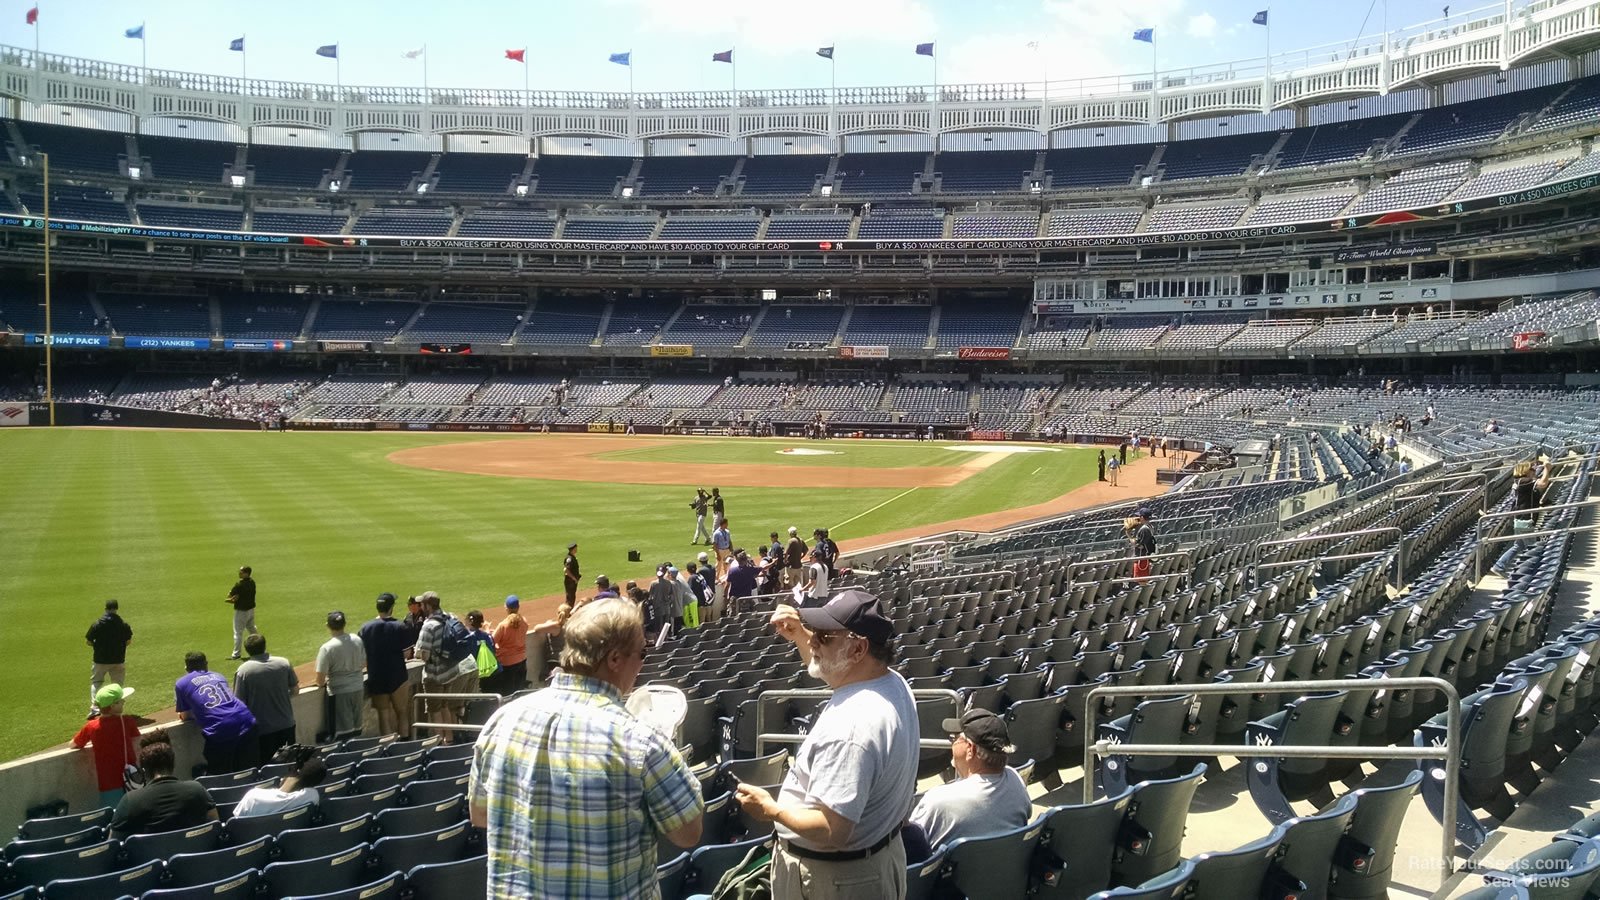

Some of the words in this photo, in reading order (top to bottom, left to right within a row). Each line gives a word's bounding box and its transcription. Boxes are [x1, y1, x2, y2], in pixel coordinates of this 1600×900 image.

[1499, 195, 1517, 206] BUY
[1519, 194, 1526, 202] A
[1527, 189, 1541, 201] $50
[1541, 181, 1579, 197] YANKEES
[1579, 175, 1599, 188] GIFT
[81, 225, 130, 235] #MobilizingNYY
[232, 233, 242, 241] the
[902, 242, 917, 250] $50
[1028, 240, 1052, 248] YOUR
[1117, 237, 1135, 245] AND
[1137, 235, 1159, 244] HAVE
[1162, 234, 1175, 243] $10
[1177, 232, 1208, 241] ADDED
[1211, 231, 1222, 239] TO
[1224, 229, 1248, 238] YOUR
[1250, 227, 1269, 237] GIFT
[1271, 225, 1297, 235] CARD
[443, 240, 479, 248] YANKEES
[1337, 251, 1366, 261] 27-Time
[1368, 248, 1390, 258] World
[1392, 246, 1432, 257] Champions
[55, 337, 74, 345] HAT
[76, 337, 100, 345] PACK
[140, 339, 159, 347] (212)
[841, 347, 853, 356] JBL
[960, 348, 1008, 358] Budweiser
[198, 683, 232, 708] 31
